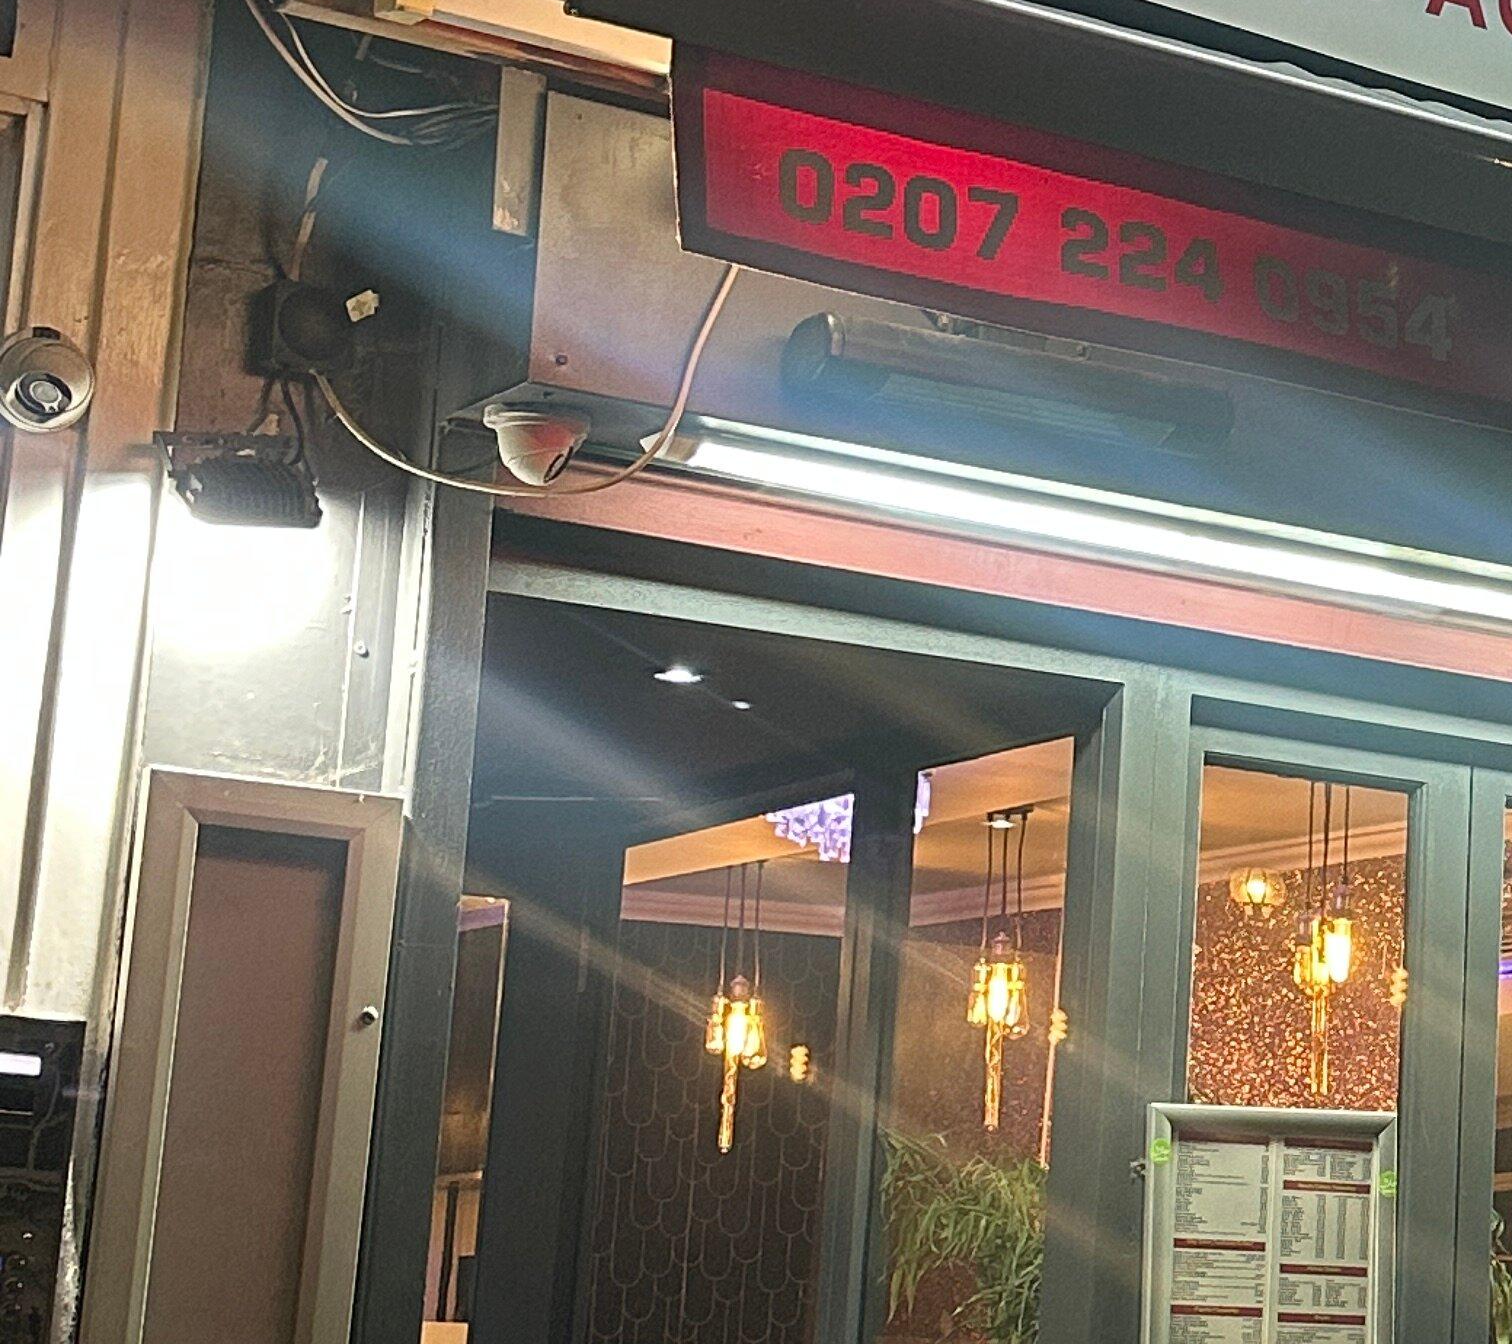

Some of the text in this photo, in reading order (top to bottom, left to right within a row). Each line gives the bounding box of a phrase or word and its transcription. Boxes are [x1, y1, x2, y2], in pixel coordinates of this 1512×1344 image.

[779, 147, 1454, 364] 0207 224 0954
